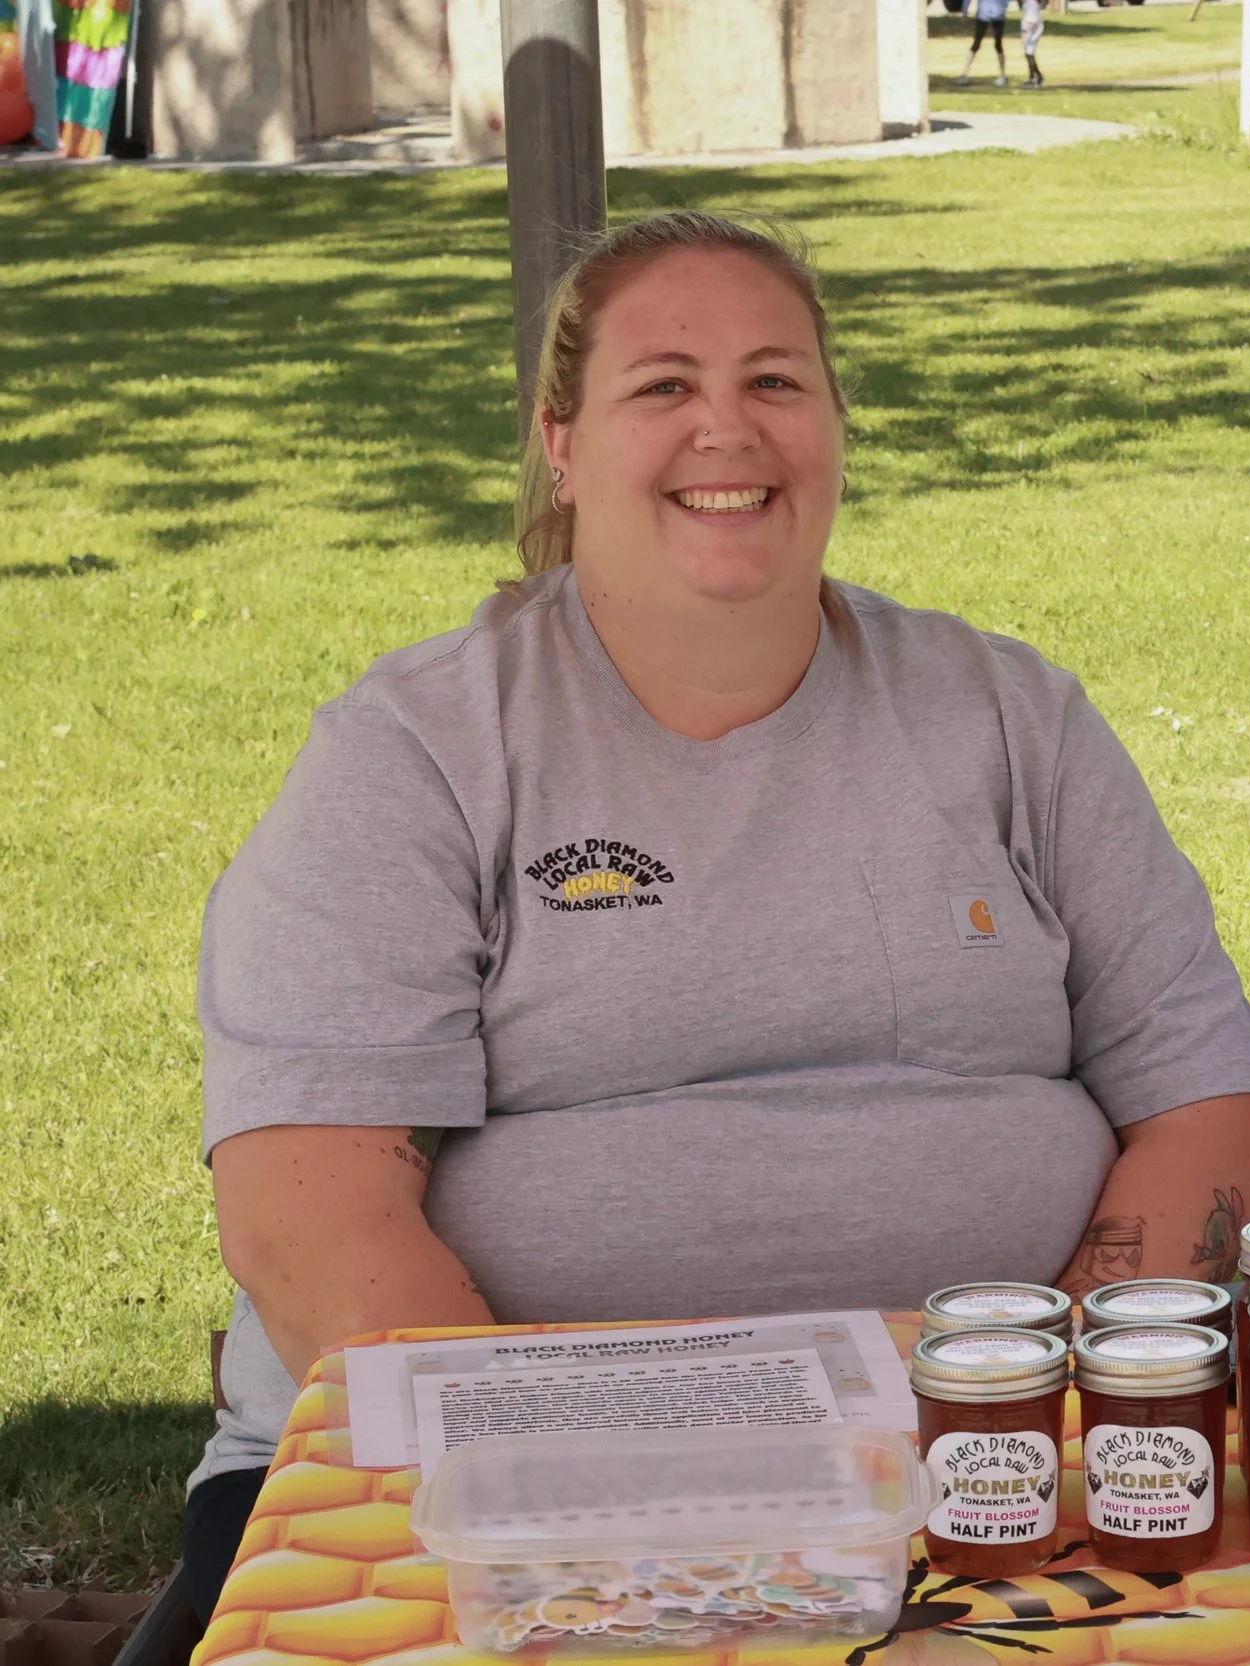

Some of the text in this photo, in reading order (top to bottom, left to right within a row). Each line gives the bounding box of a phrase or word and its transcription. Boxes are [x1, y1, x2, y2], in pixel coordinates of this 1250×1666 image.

[524, 839, 675, 883] BLACK DIAMOND
[542, 854, 656, 890] LOCAL RAW
[563, 871, 635, 900] HONEY
[540, 894, 663, 911] TONASKET, WA
[496, 1330, 754, 1354] BLACK DIAMOND HONEY
[945, 1437, 1045, 1473] BLACK DIAMOND
[1096, 1431, 1195, 1466] BLACK DIAMOND
[965, 1457, 1028, 1475] LOCAL RAW
[1113, 1450, 1177, 1469] LOCAL RAW
[953, 1475, 1041, 1495] HONEY
[1104, 1469, 1191, 1489] HONEY
[960, 1497, 1014, 1507] TONASKET,
[1110, 1489, 1162, 1501] TONASKET,
[948, 1508, 1039, 1521] FRUIT BLOSSOM
[1101, 1500, 1190, 1515] FRUIT BLOSSOM
[951, 1522, 1037, 1538] HALF PINT
[1103, 1514, 1187, 1532] HALF PINT
